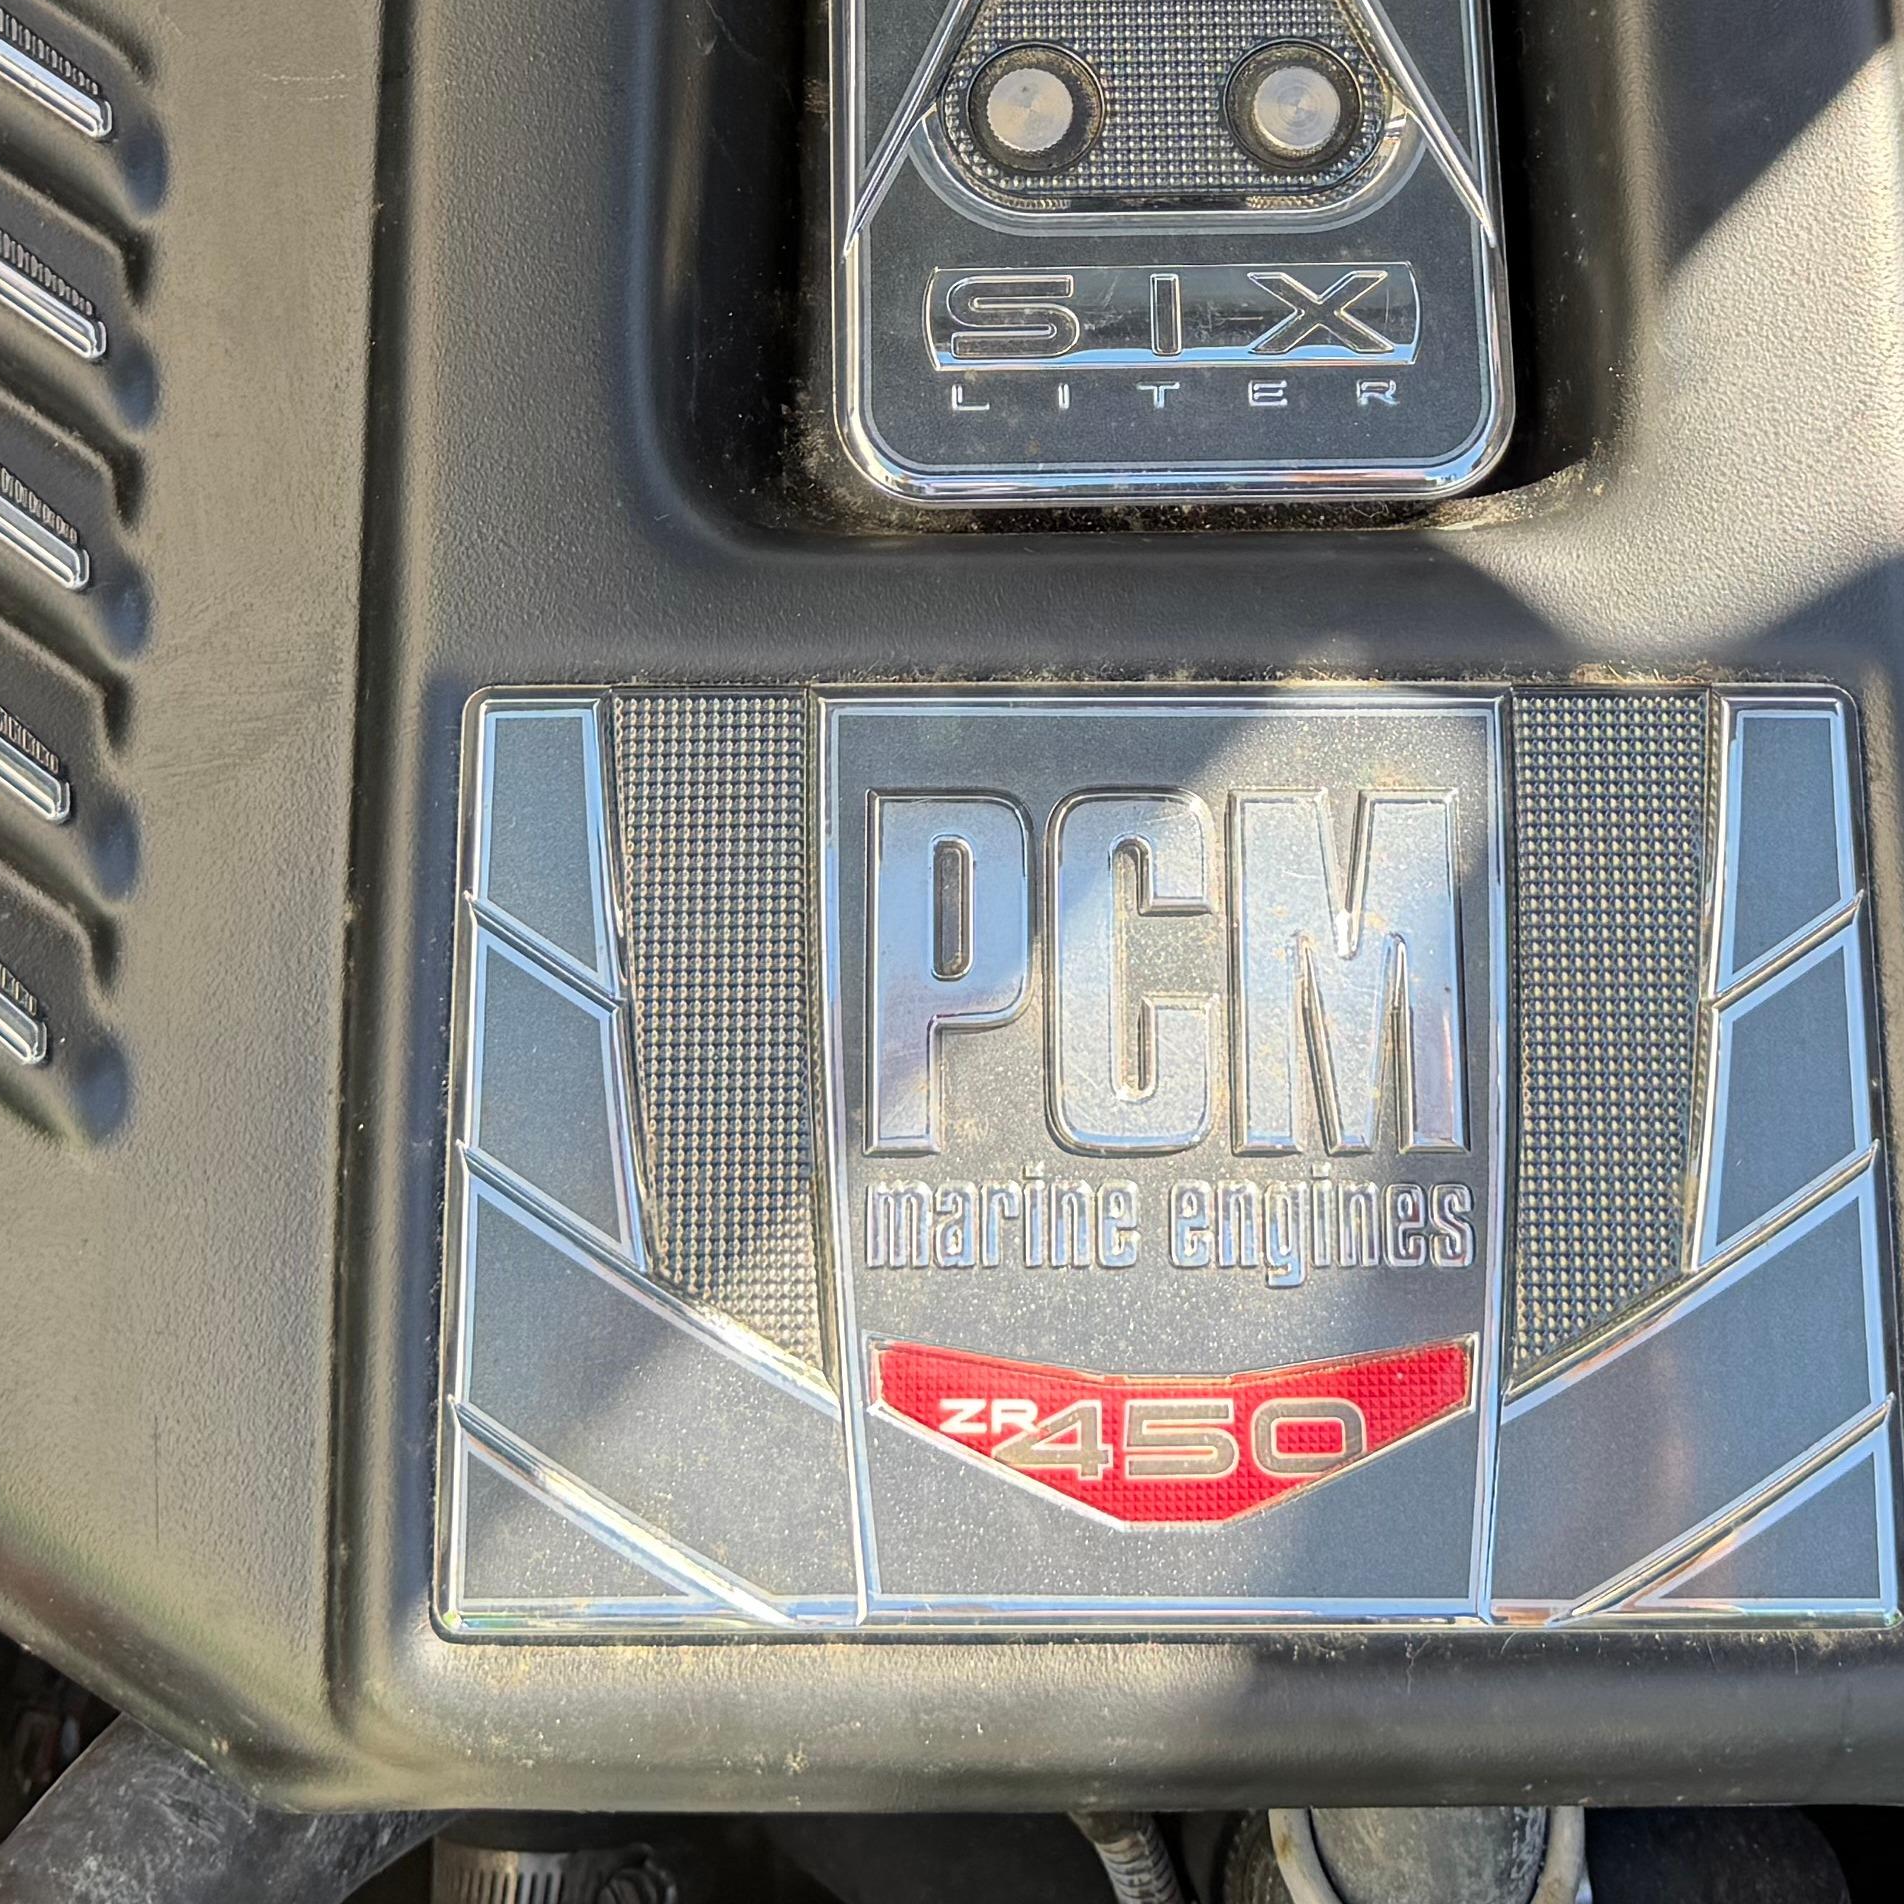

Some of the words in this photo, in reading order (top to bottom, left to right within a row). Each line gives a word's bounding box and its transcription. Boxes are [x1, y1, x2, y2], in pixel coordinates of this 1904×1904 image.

[945, 268, 1398, 360] SIX
[950, 379, 1401, 413] LITER
[861, 786, 1470, 1158] PCM
[863, 1160, 1141, 1271] marine
[1169, 1160, 1477, 1290] engines
